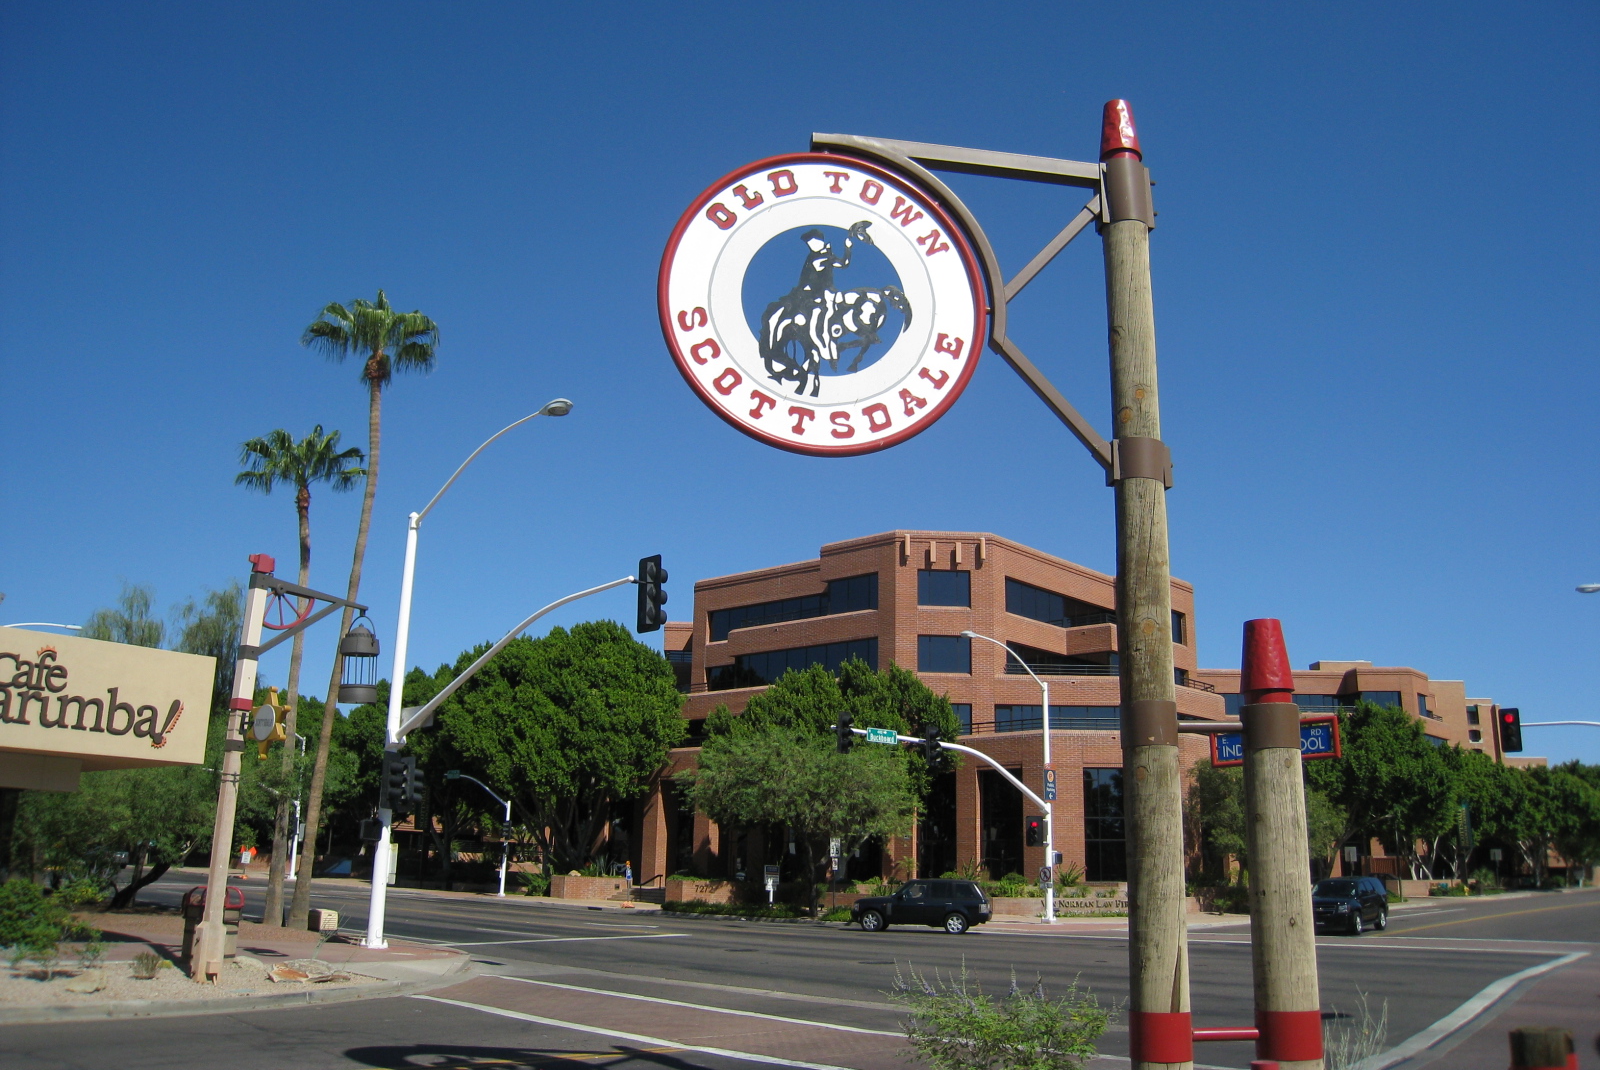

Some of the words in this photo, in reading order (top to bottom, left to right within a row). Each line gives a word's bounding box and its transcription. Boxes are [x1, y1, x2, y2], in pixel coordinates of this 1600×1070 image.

[706, 169, 798, 231] OLD
[823, 171, 950, 257] TOWN
[677, 306, 965, 439] SCOTTSDALE
[0, 652, 68, 693] Cafe
[870, 733, 894, 743] Buckboard
[1222, 737, 1229, 745] E.
[1310, 728, 1324, 736] RD.
[695, 885, 715, 893] 7272
